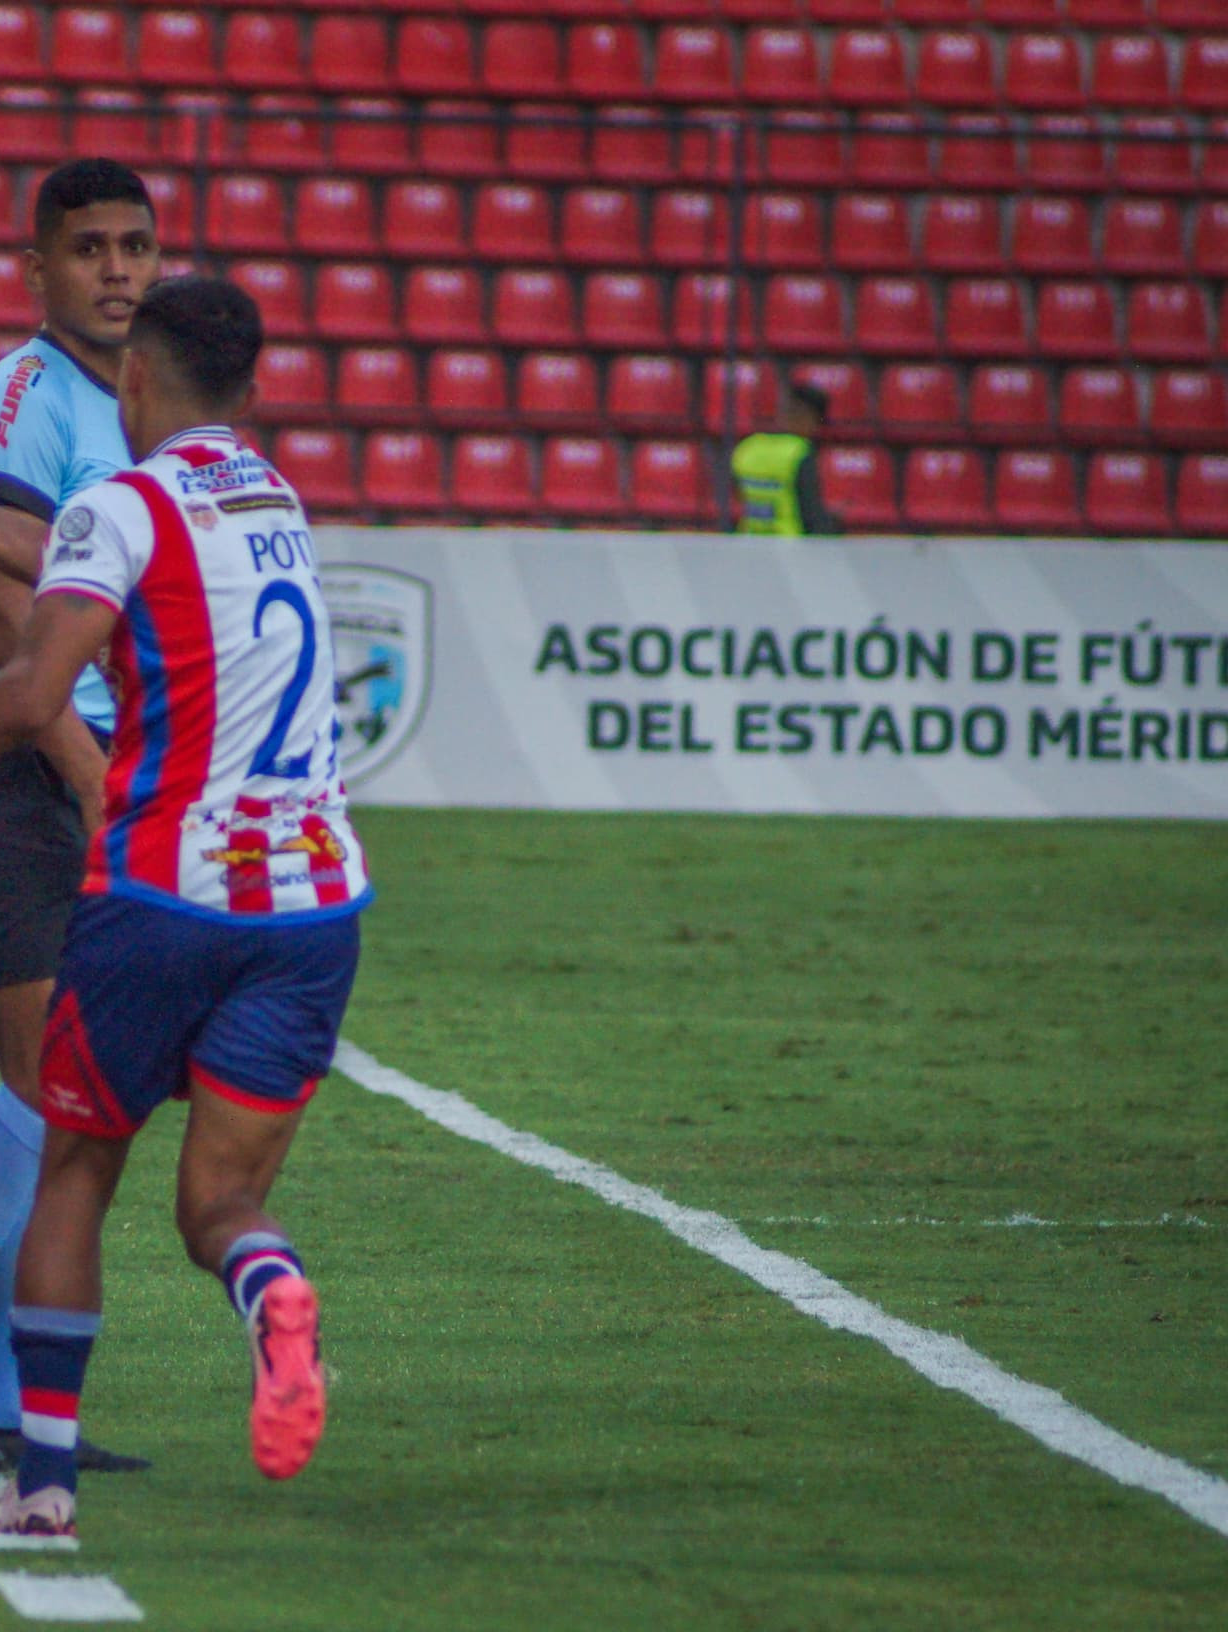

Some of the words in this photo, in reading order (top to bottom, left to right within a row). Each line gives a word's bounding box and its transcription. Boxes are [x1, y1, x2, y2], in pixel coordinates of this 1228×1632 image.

[535, 615, 952, 683] ASOCIACIÓN
[971, 630, 1060, 686] DE
[587, 700, 714, 754] DEL
[734, 703, 1009, 759] ESTADO
